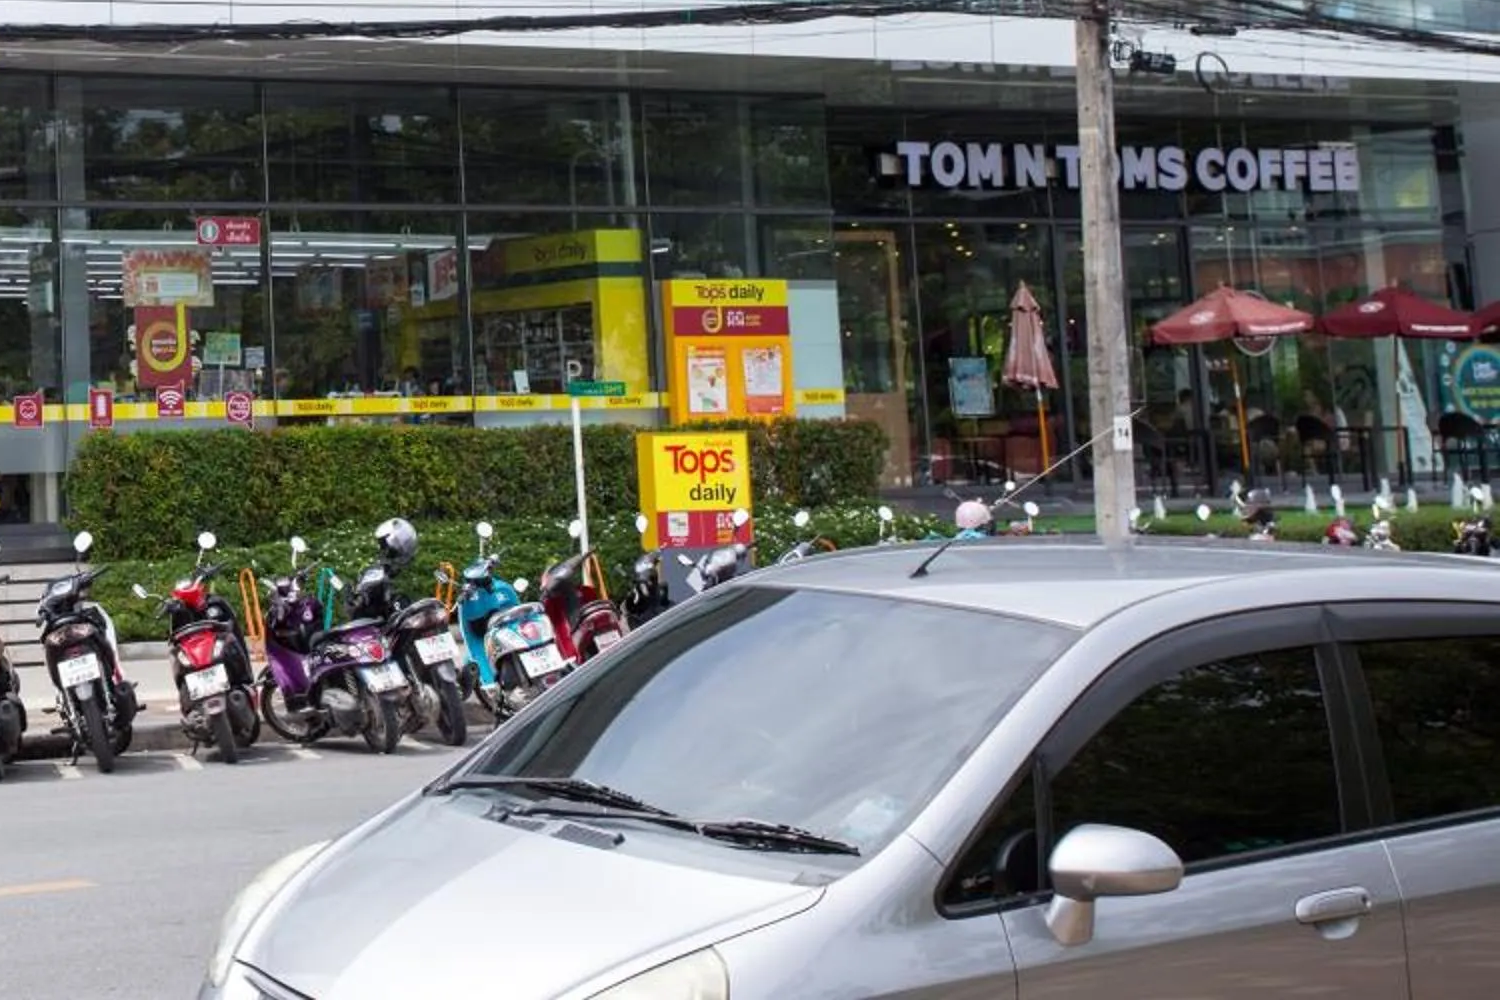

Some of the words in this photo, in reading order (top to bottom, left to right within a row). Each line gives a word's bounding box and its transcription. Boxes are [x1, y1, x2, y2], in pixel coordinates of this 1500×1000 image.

[897, 141, 1003, 189] TOM
[1014, 142, 1047, 189] N
[1056, 143, 1188, 192] TMS
[1196, 146, 1359, 193] COFFEE
[694, 285, 726, 302] Tops
[729, 284, 765, 301] daily
[664, 444, 735, 484] Tops
[689, 483, 737, 504] daily
